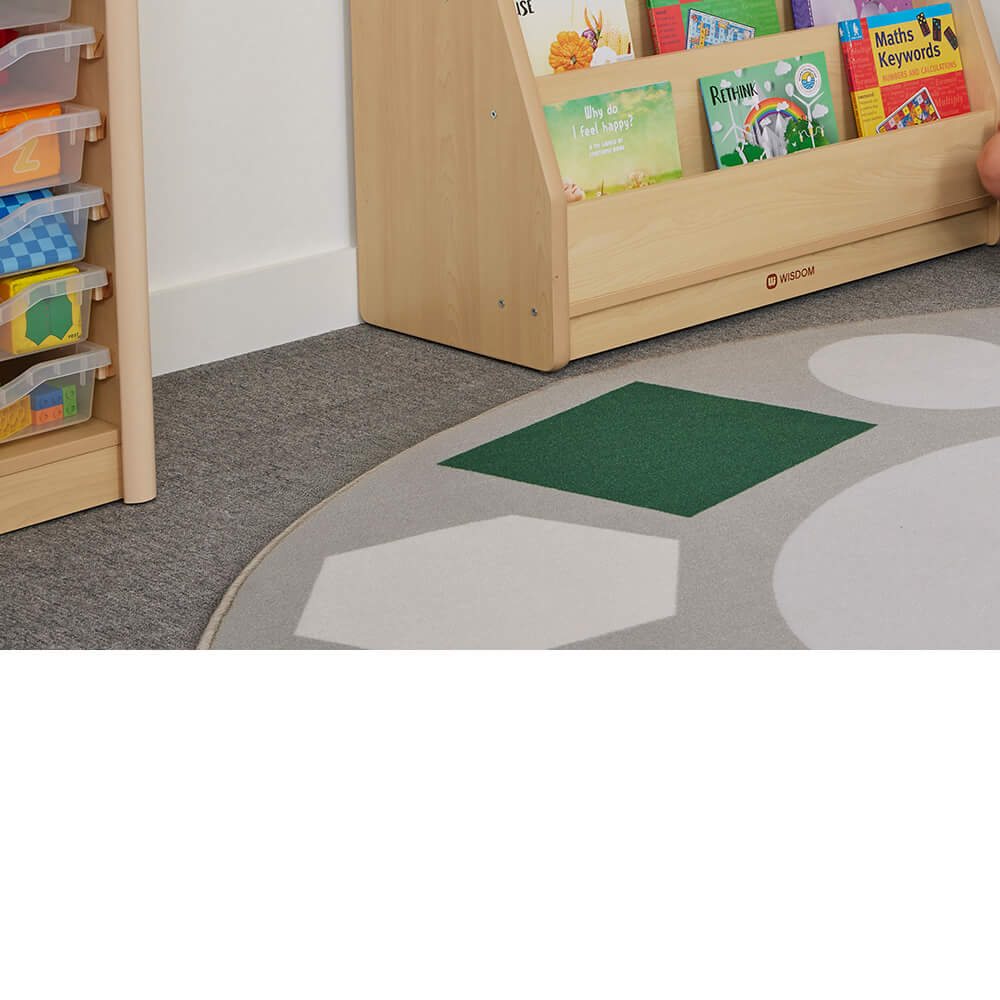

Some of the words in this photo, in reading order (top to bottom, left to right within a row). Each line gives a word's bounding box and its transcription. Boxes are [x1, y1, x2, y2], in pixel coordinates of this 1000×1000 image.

[875, 27, 915, 48] Maths
[878, 42, 941, 69] Keywords
[709, 82, 759, 106] RETHINK
[584, 104, 604, 120] Why
[606, 104, 618, 115] do
[572, 124, 577, 139] I
[580, 122, 599, 137] feel
[601, 114, 633, 133] happy?
[780, 265, 815, 283] WISDOM
